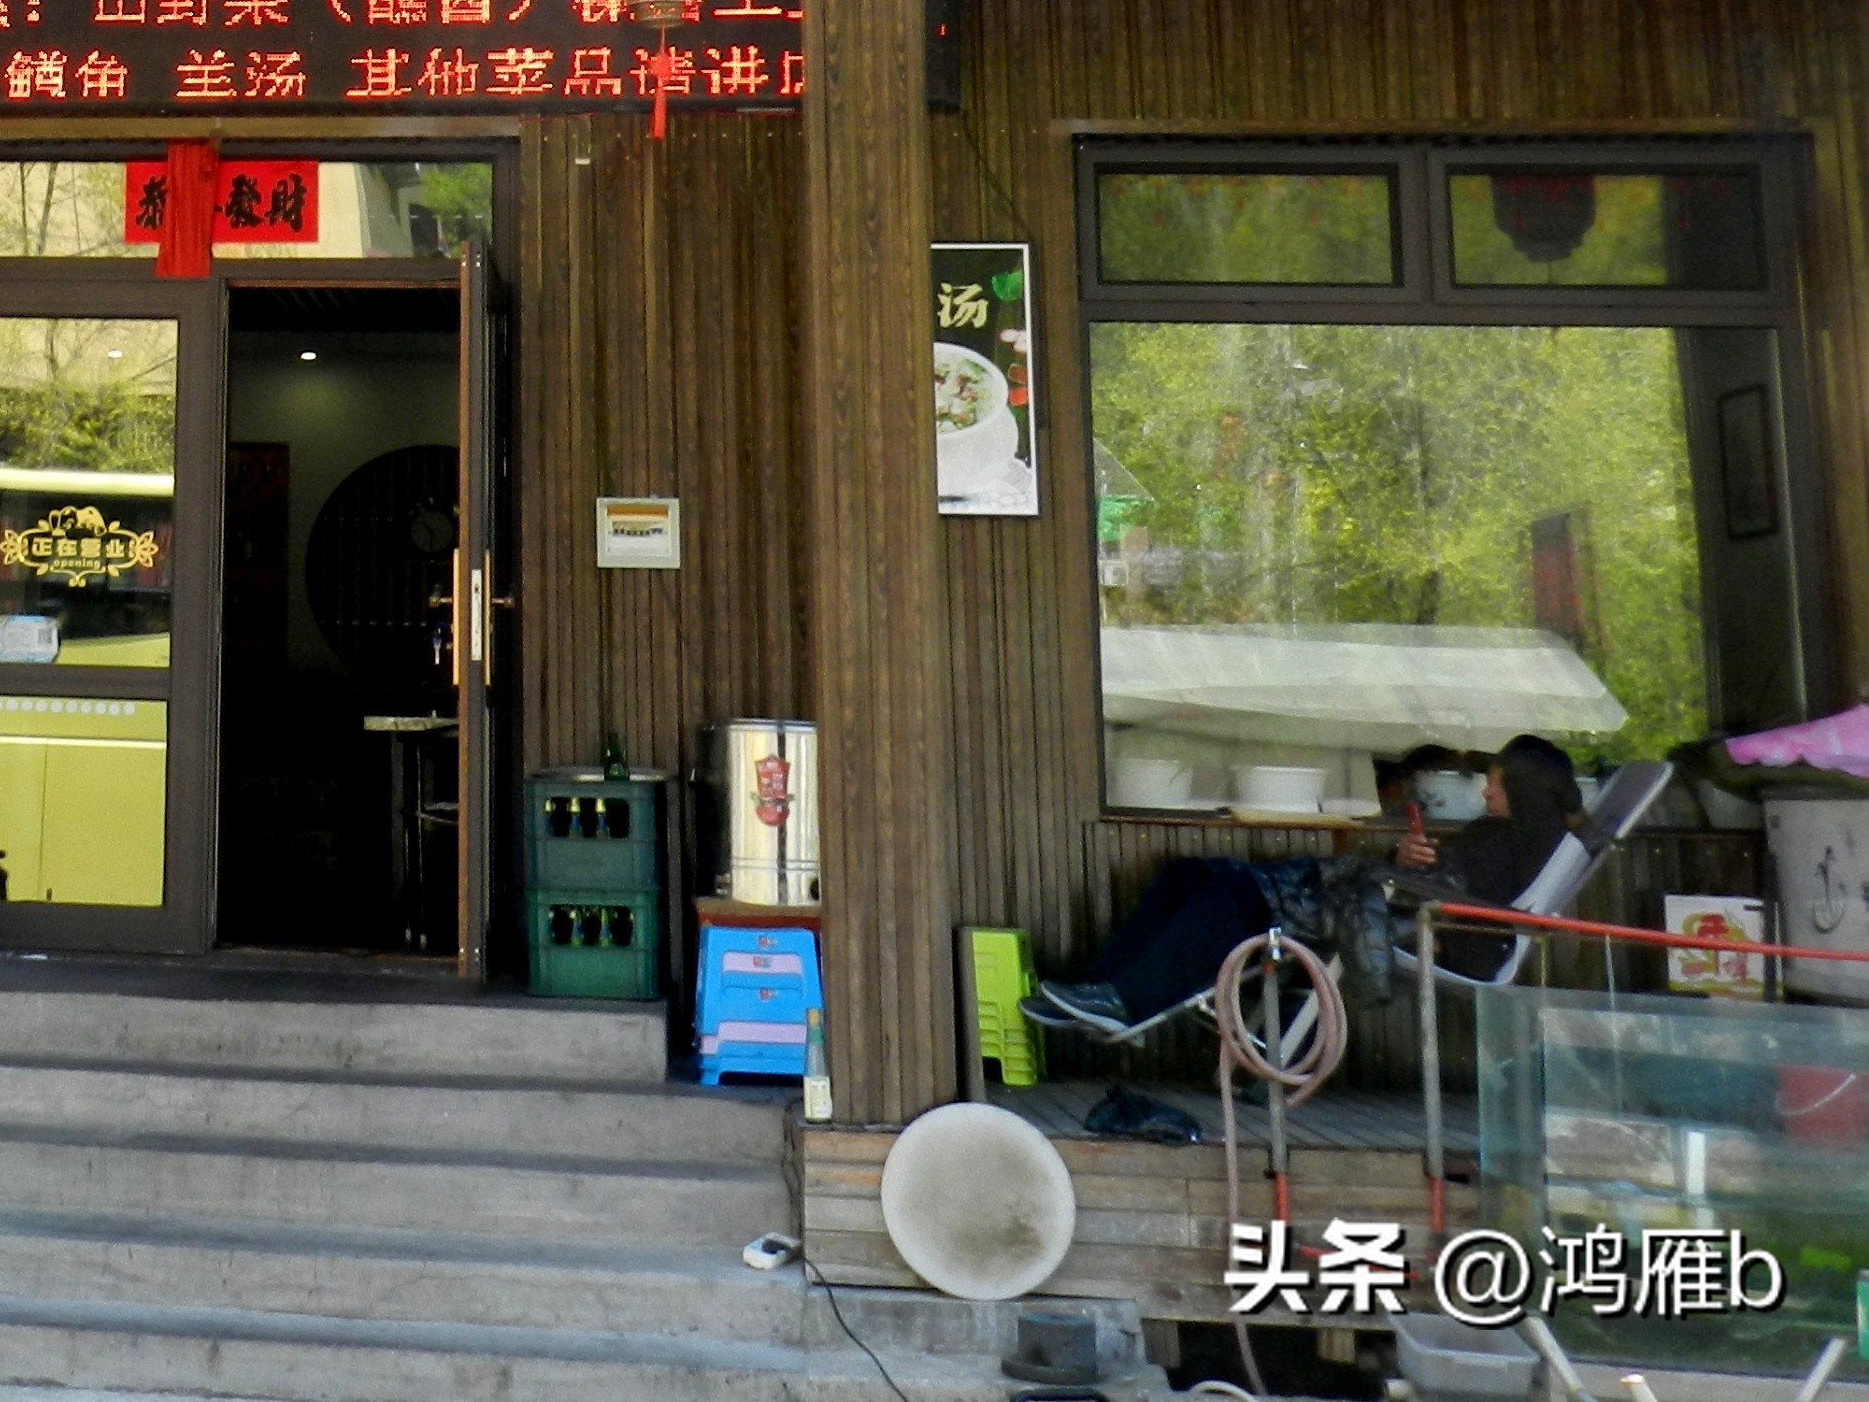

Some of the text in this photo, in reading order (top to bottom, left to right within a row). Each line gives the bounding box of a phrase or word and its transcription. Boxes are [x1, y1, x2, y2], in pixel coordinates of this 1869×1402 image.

[937, 282, 988, 328] 汤
[31, 537, 125, 558] 正在营业
[53, 558, 101, 569] opening
